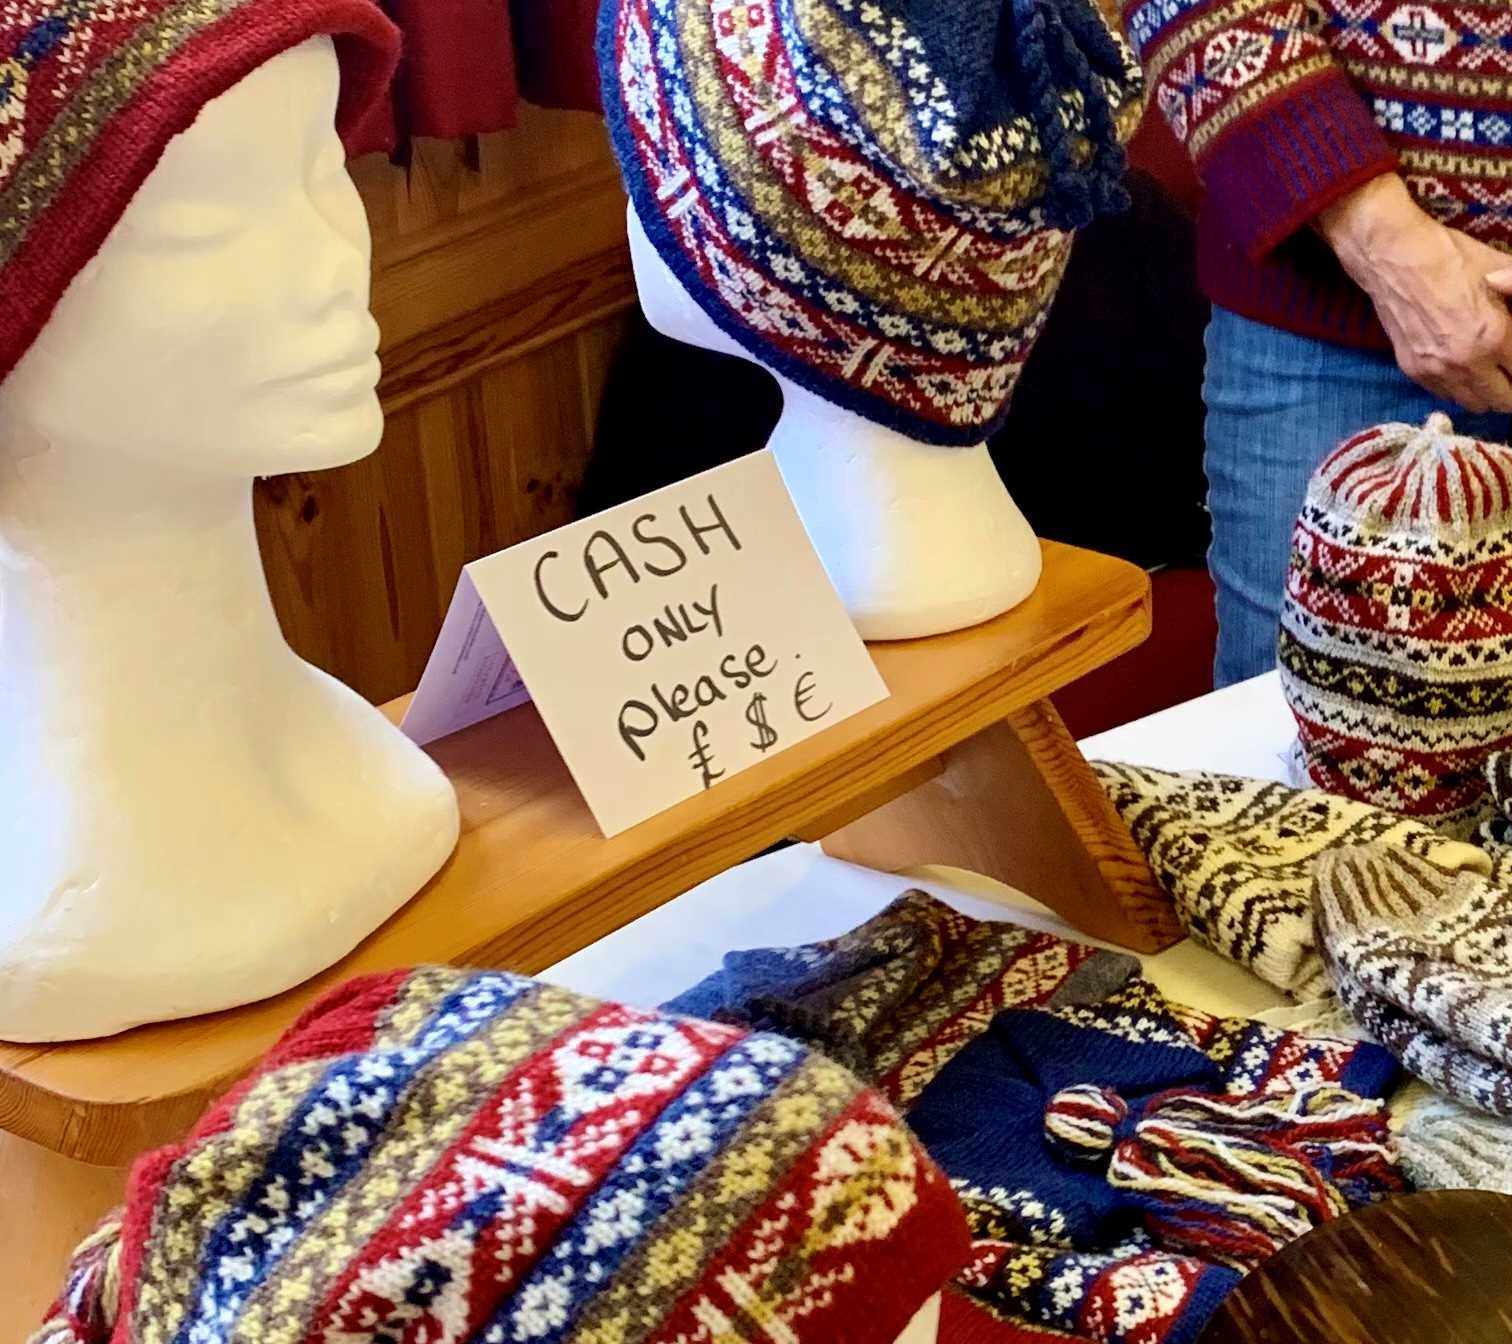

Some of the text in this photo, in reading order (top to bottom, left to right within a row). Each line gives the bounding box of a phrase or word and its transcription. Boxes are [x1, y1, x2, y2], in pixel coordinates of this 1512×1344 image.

[535, 495, 742, 621] CASH
[623, 584, 723, 661] ONLY
[689, 672, 832, 790] £ $ €
